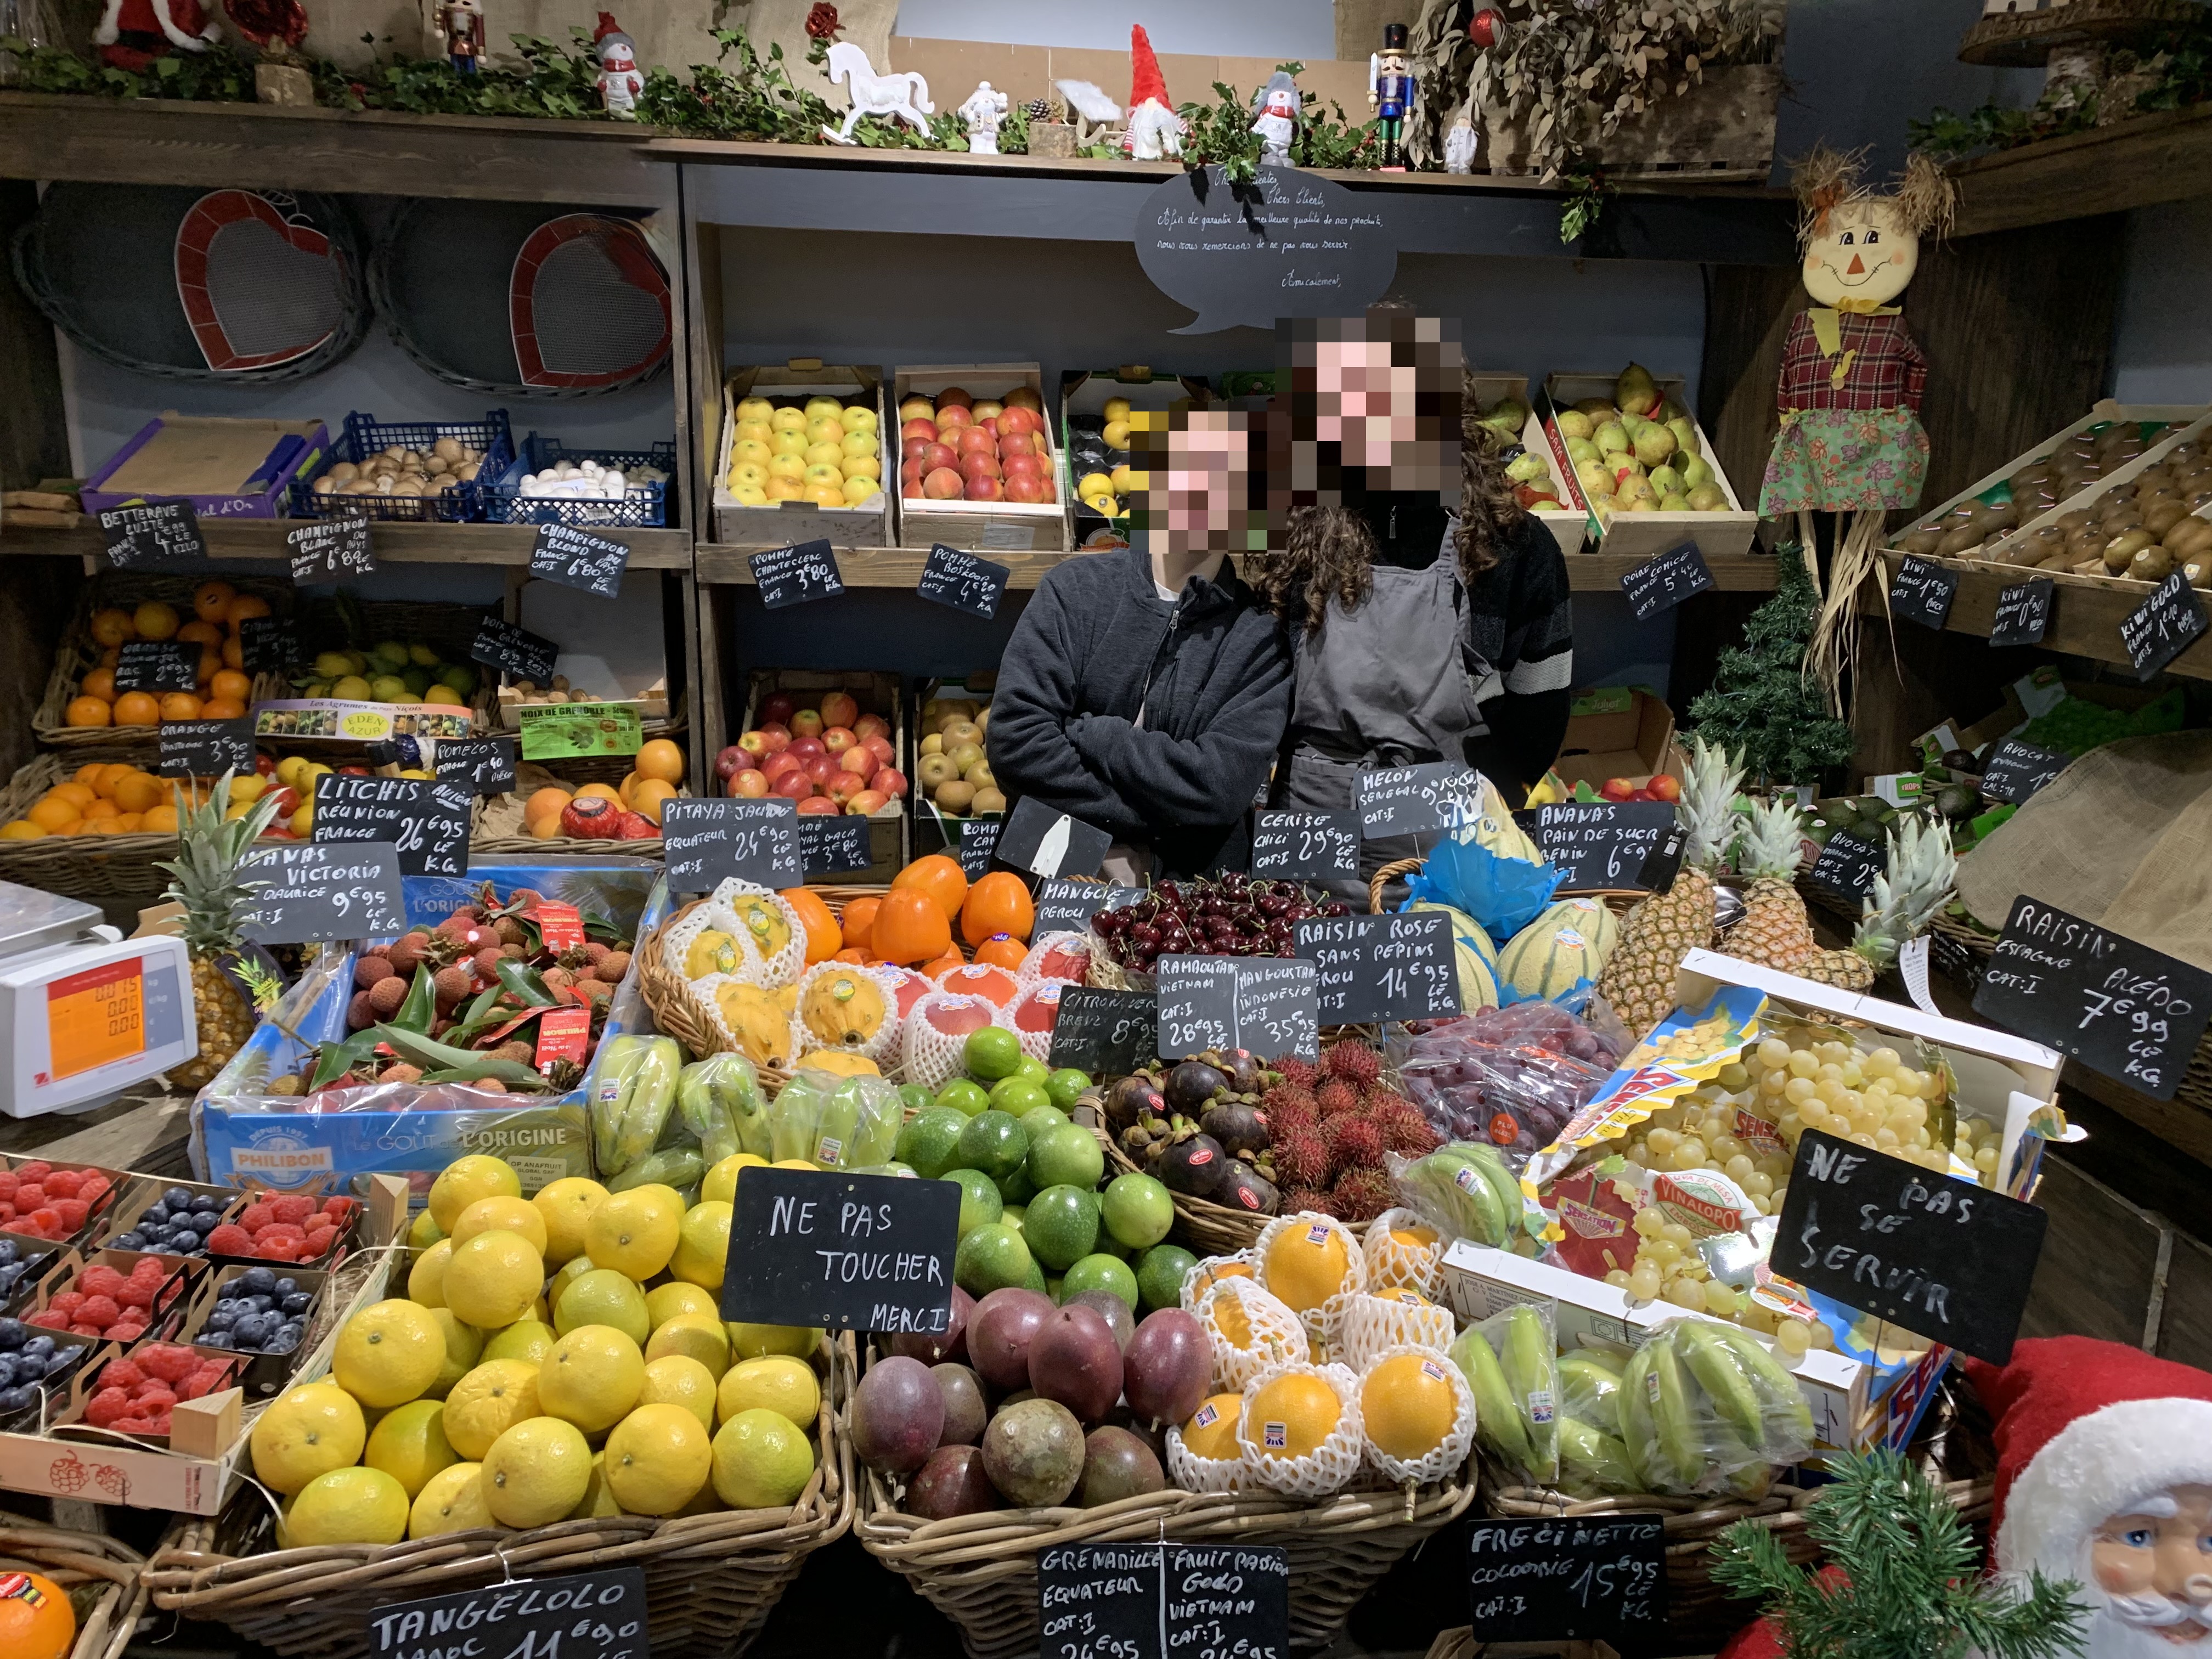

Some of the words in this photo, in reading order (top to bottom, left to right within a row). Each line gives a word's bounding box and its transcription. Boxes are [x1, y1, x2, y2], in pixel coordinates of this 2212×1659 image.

[1188, 212, 1197, 224] de
[1201, 213, 1232, 231] garantir
[1254, 212, 1289, 224] meilleure
[1324, 214, 1330, 225] de
[1157, 240, 1175, 250] nous
[1202, 241, 1251, 251] remercions
[1257, 238, 1265, 249] de
[1282, 242, 1295, 254] pas
[1549, 428, 1564, 460] SAM
[1561, 461, 1584, 510] FRUITS
[100, 505, 179, 529] BETTERAVE
[126, 518, 164, 535] CUITE
[172, 540, 200, 554] KILO
[300, 536, 337, 554] BLANC
[547, 538, 589, 556] BLOND
[943, 562, 990, 582] BOSKOOP
[326, 701, 369, 710] Agrumes
[161, 723, 224, 736] ORANGE
[347, 714, 385, 726] EDEN
[347, 725, 381, 736] AZUR
[438, 742, 499, 759] POMELOS
[2002, 742, 2056, 762] AVOCAT
[317, 777, 420, 802] LITCHIS
[1363, 769, 1419, 792] MELON
[1359, 785, 1419, 806] SENEGAL
[665, 800, 726, 823] PITAYA
[1540, 805, 1617, 828] ANANAS
[1543, 827, 1579, 845] PAIN
[1584, 828, 1609, 842] DE
[1830, 832, 1878, 857] AVOCAT
[286, 860, 382, 887] VICTORIA
[1040, 907, 1085, 920] PEROU
[1299, 920, 1370, 946] RAISIN
[1390, 918, 1443, 939] ROSE
[2016, 905, 2102, 959] RAISIN
[1160, 959, 1235, 975] RAMBOUTAN
[1316, 947, 1361, 968] SANS
[1160, 978, 1214, 995] VIETNAM
[1239, 965, 1317, 990] MANGOUSTAN
[462, 1128, 567, 1148] L'ORIGINE
[238, 1153, 325, 1167] PHILIBON
[524, 1161, 563, 1170] ANAFRUIT
[1696, 1177, 1710, 1186] DE
[1711, 1182, 1734, 1204] MESA
[1805, 1143, 1867, 1185] NE
[1899, 1183, 1974, 1223] PAS
[769, 1195, 818, 1237] NE
[840, 1201, 892, 1238] PAS
[1564, 1203, 1618, 1234] SENSATION
[1859, 1203, 1912, 1234] SE
[815, 1249, 944, 1287] TOUCHER
[870, 1303, 946, 1334] MERCI
[1174, 1549, 1232, 1572] FRUIT
[371, 1583, 625, 1651] TANGELOLO
[1169, 1598, 1255, 1621] VIETNAM
